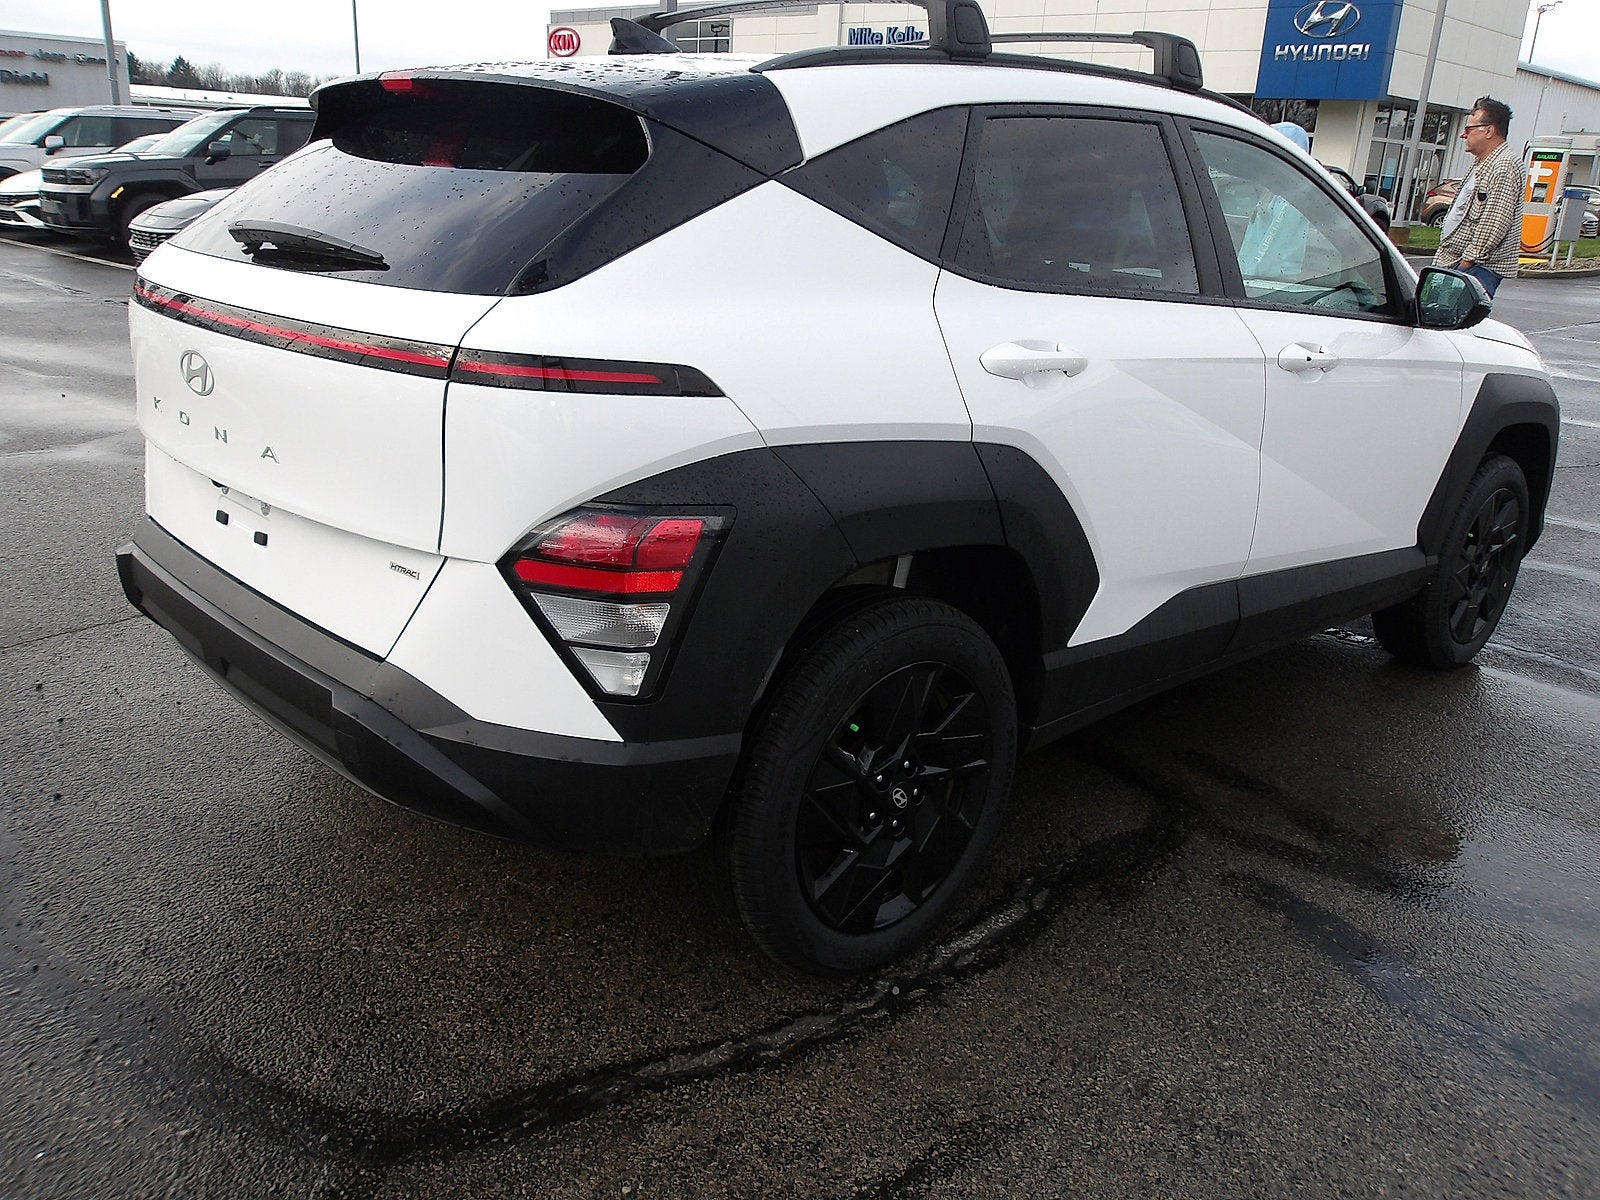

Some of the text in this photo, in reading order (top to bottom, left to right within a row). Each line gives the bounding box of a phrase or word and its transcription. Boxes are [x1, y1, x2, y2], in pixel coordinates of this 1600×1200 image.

[553, 34, 575, 51] KIA
[848, 26, 924, 46] Mike Kelly
[1273, 43, 1371, 61] HYUNDAI
[153, 396, 280, 465] KONA
[390, 562, 419, 580] HTRAC
